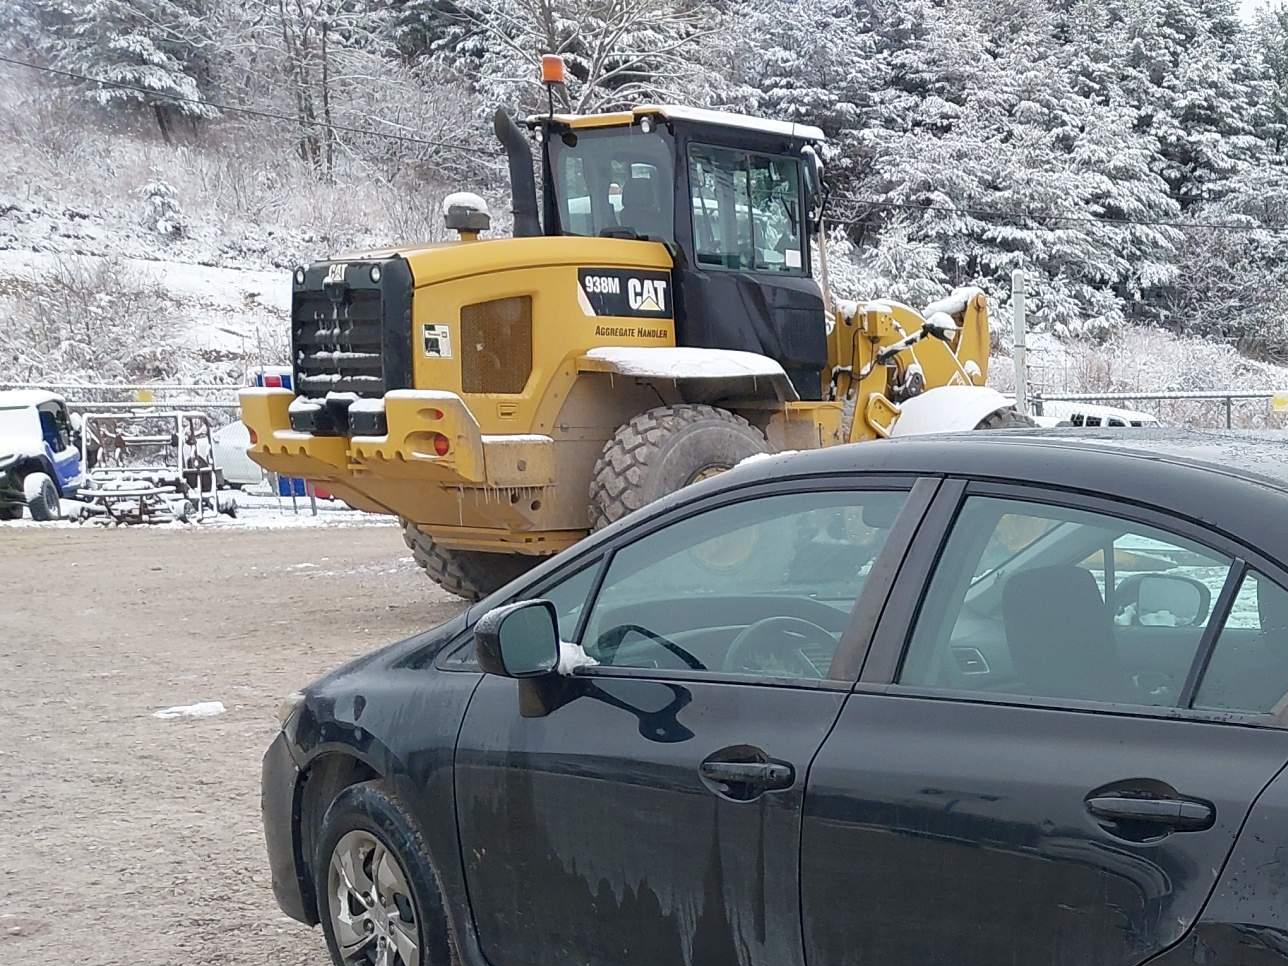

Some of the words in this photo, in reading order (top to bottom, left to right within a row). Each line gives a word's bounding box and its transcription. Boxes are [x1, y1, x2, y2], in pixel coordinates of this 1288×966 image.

[329, 264, 348, 281] CAT
[585, 276, 620, 294] 938M
[627, 278, 667, 312] CAT
[637, 327, 668, 339] HANDLER
